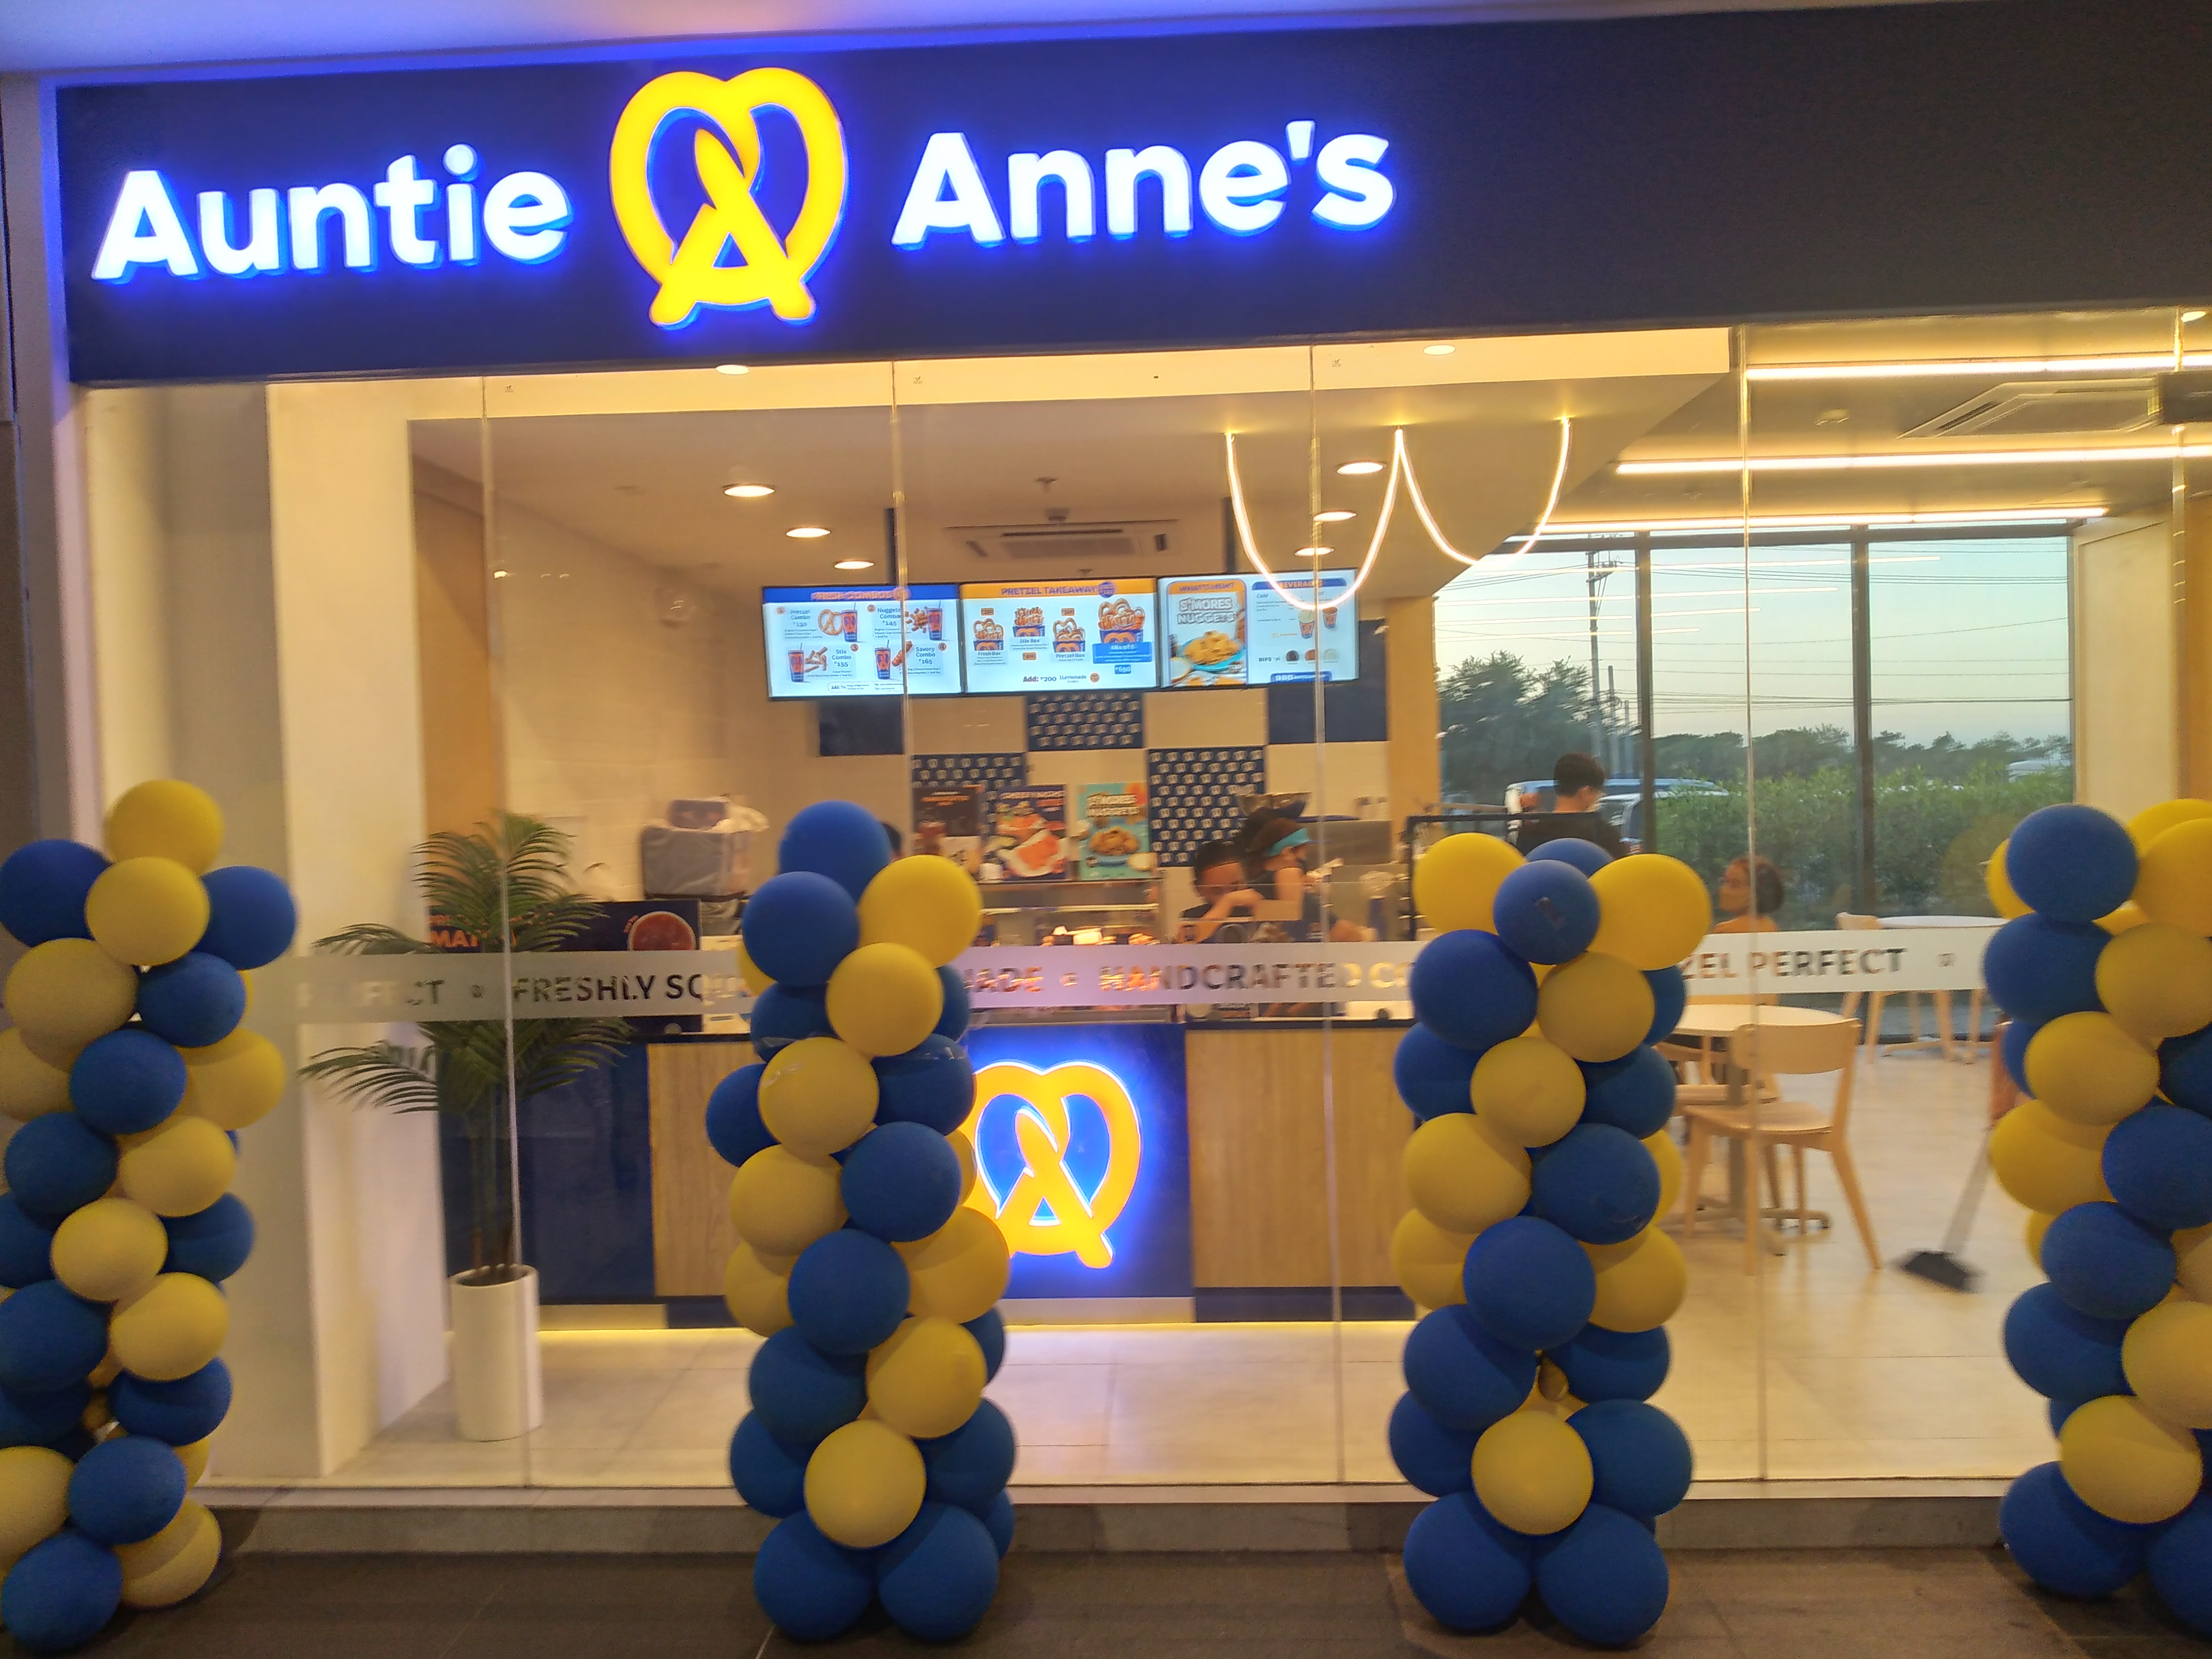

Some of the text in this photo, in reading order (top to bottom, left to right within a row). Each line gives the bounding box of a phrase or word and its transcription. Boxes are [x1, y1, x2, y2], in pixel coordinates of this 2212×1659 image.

[90, 120, 1396, 281] Auntie Anne's
[1001, 587, 1042, 596] PRETZEL
[1179, 597, 1233, 611] S'MORES
[1177, 612, 1236, 624] NUGGETS
[513, 975, 655, 1002] FRESHLY
[1099, 962, 1362, 992] HANDCRAFTED
[1747, 947, 1908, 978] PERFECT
